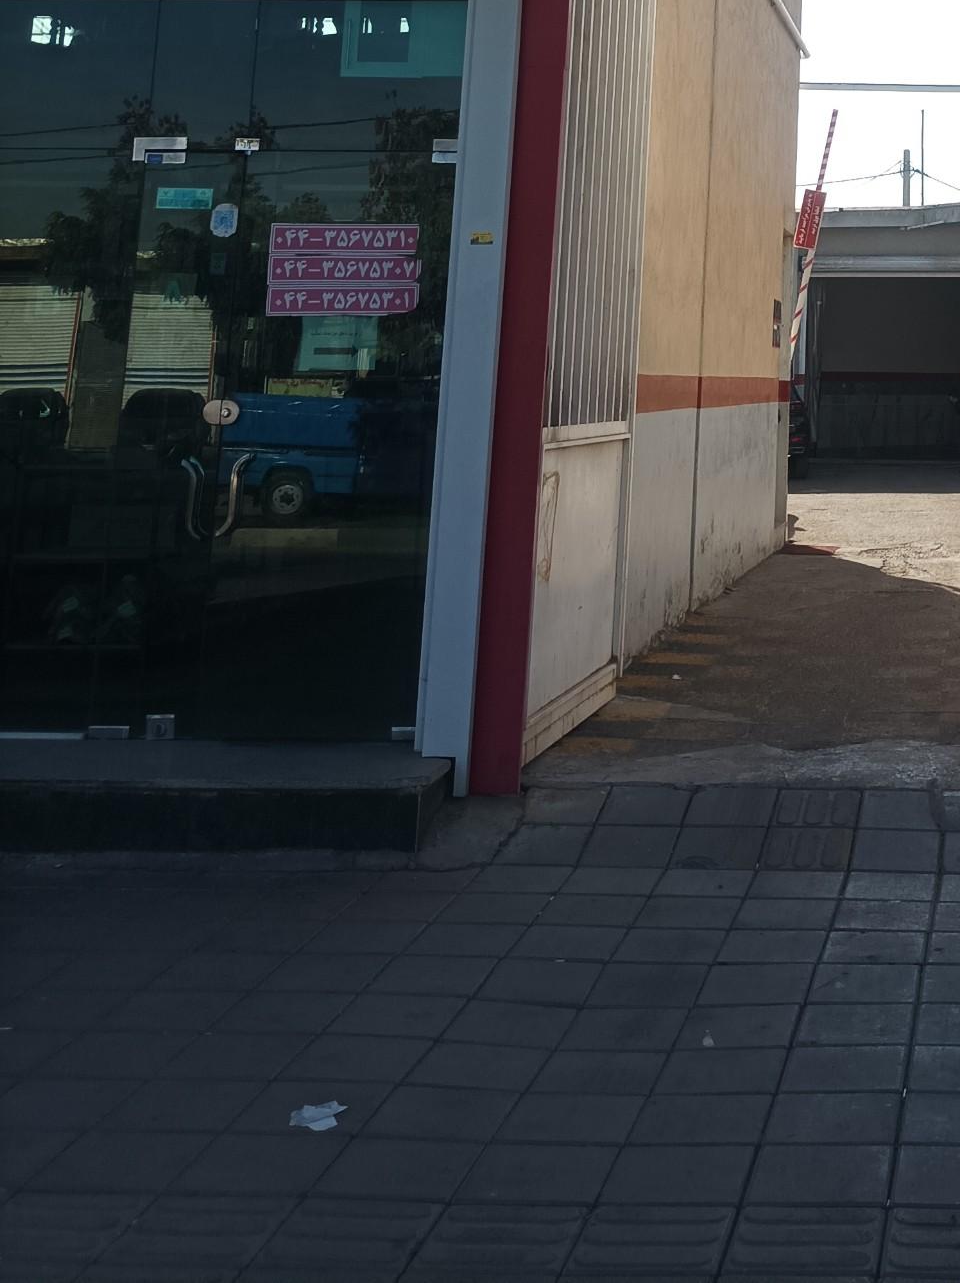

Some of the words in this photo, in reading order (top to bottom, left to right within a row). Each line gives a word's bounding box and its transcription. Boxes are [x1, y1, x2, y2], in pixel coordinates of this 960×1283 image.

[275, 229, 415, 248] ۰۴۴-۳۵۶۷۵۳۱۰
[275, 260, 415, 279] ۰۴۴-۳۵۶۷۵۳۰۷
[275, 291, 410, 310] ۰۴۴-۳۵۶۷۵۳۰۱
